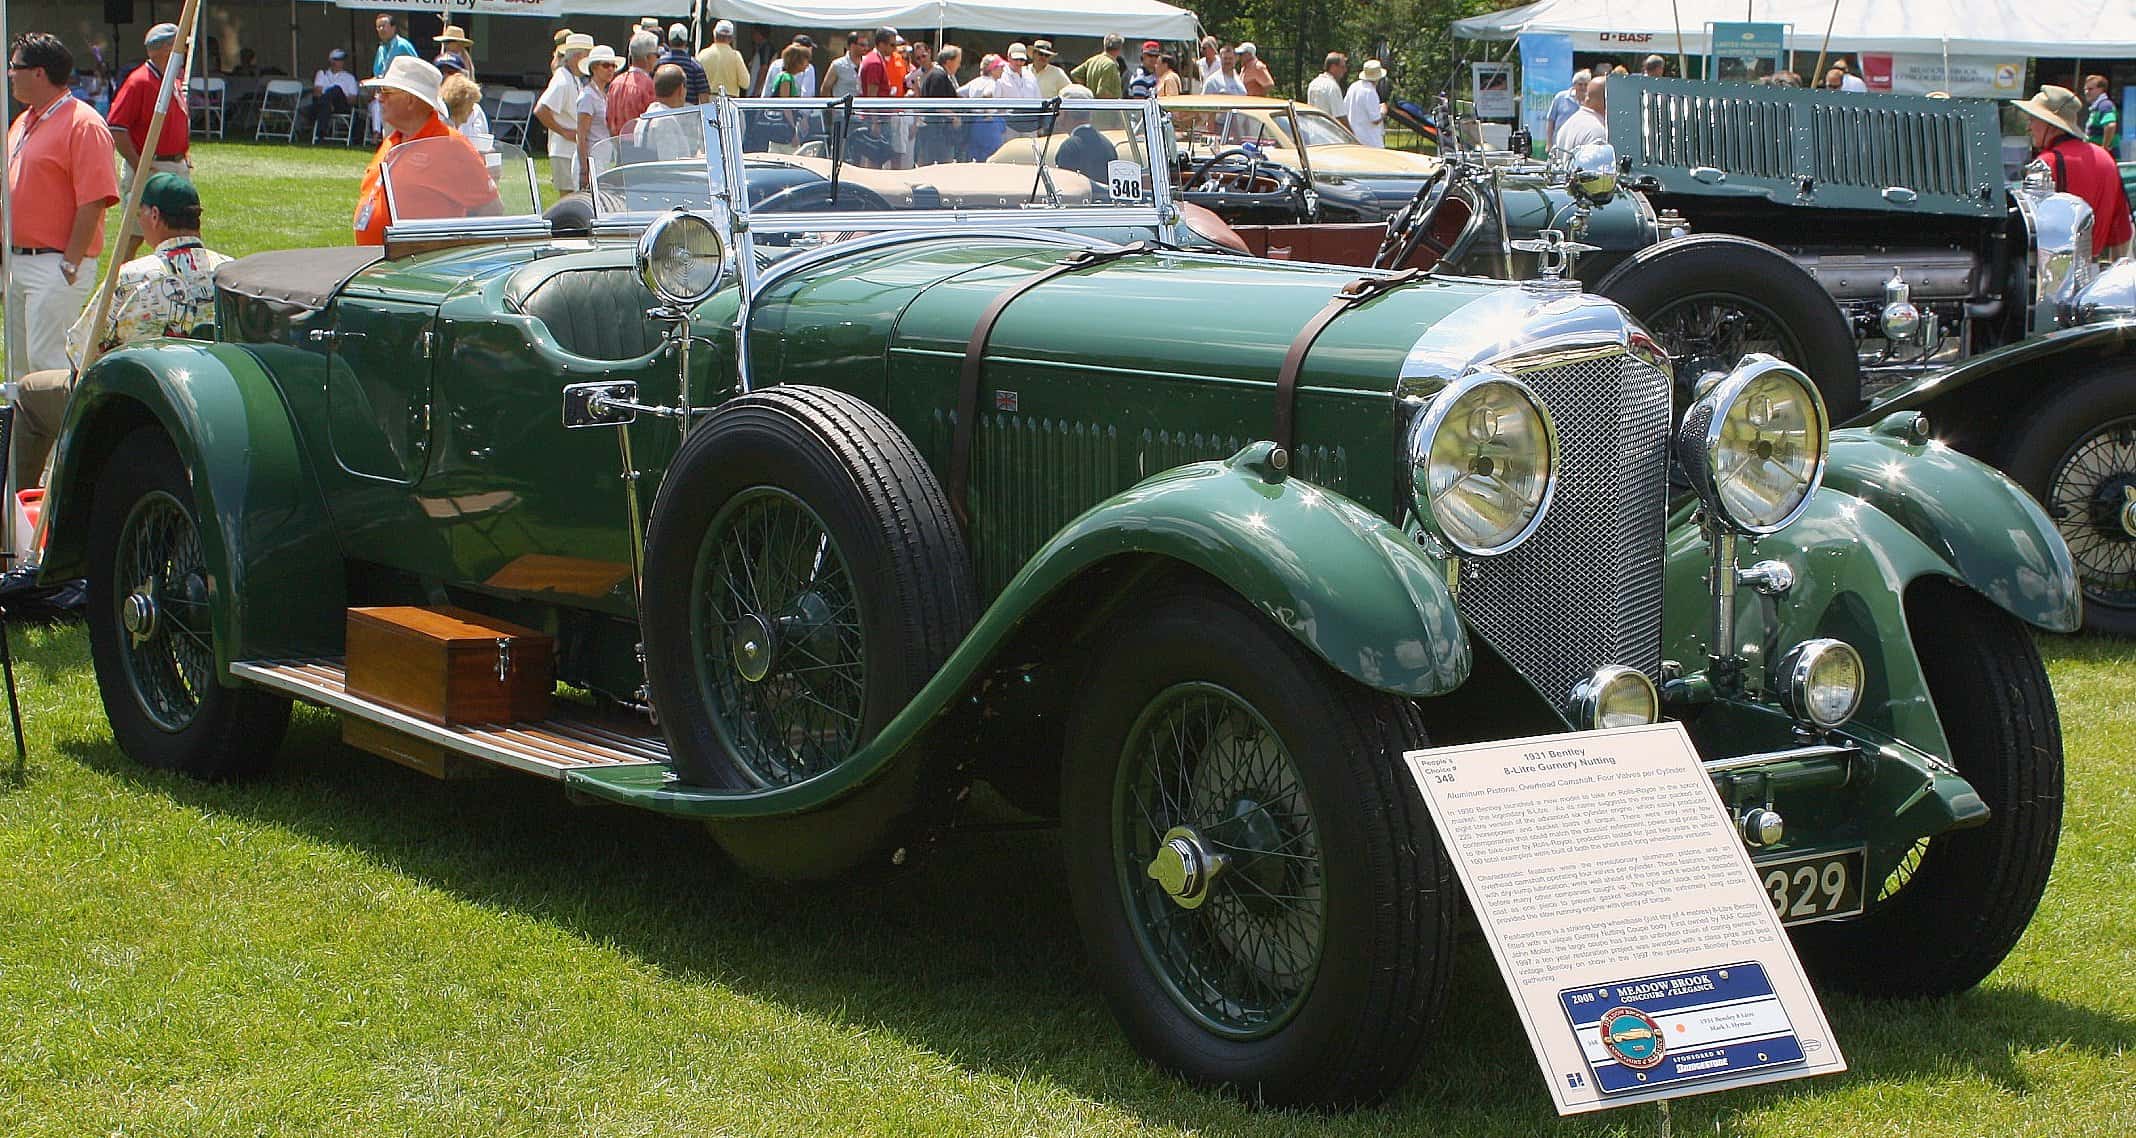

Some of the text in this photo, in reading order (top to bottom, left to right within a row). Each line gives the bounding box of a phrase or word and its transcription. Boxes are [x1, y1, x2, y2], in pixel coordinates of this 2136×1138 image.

[1618, 33, 1653, 43] BASF
[1112, 179, 1140, 198] 348
[1524, 747, 1586, 760] 1931 Bentley
[1580, 756, 1616, 767] Nutting
[1435, 775, 1455, 783] 348
[1764, 861, 1847, 918] 329
[1571, 974, 1711, 1004] 2008 MEADOW BROOK
[1620, 991, 1665, 1003] CONCOURS
